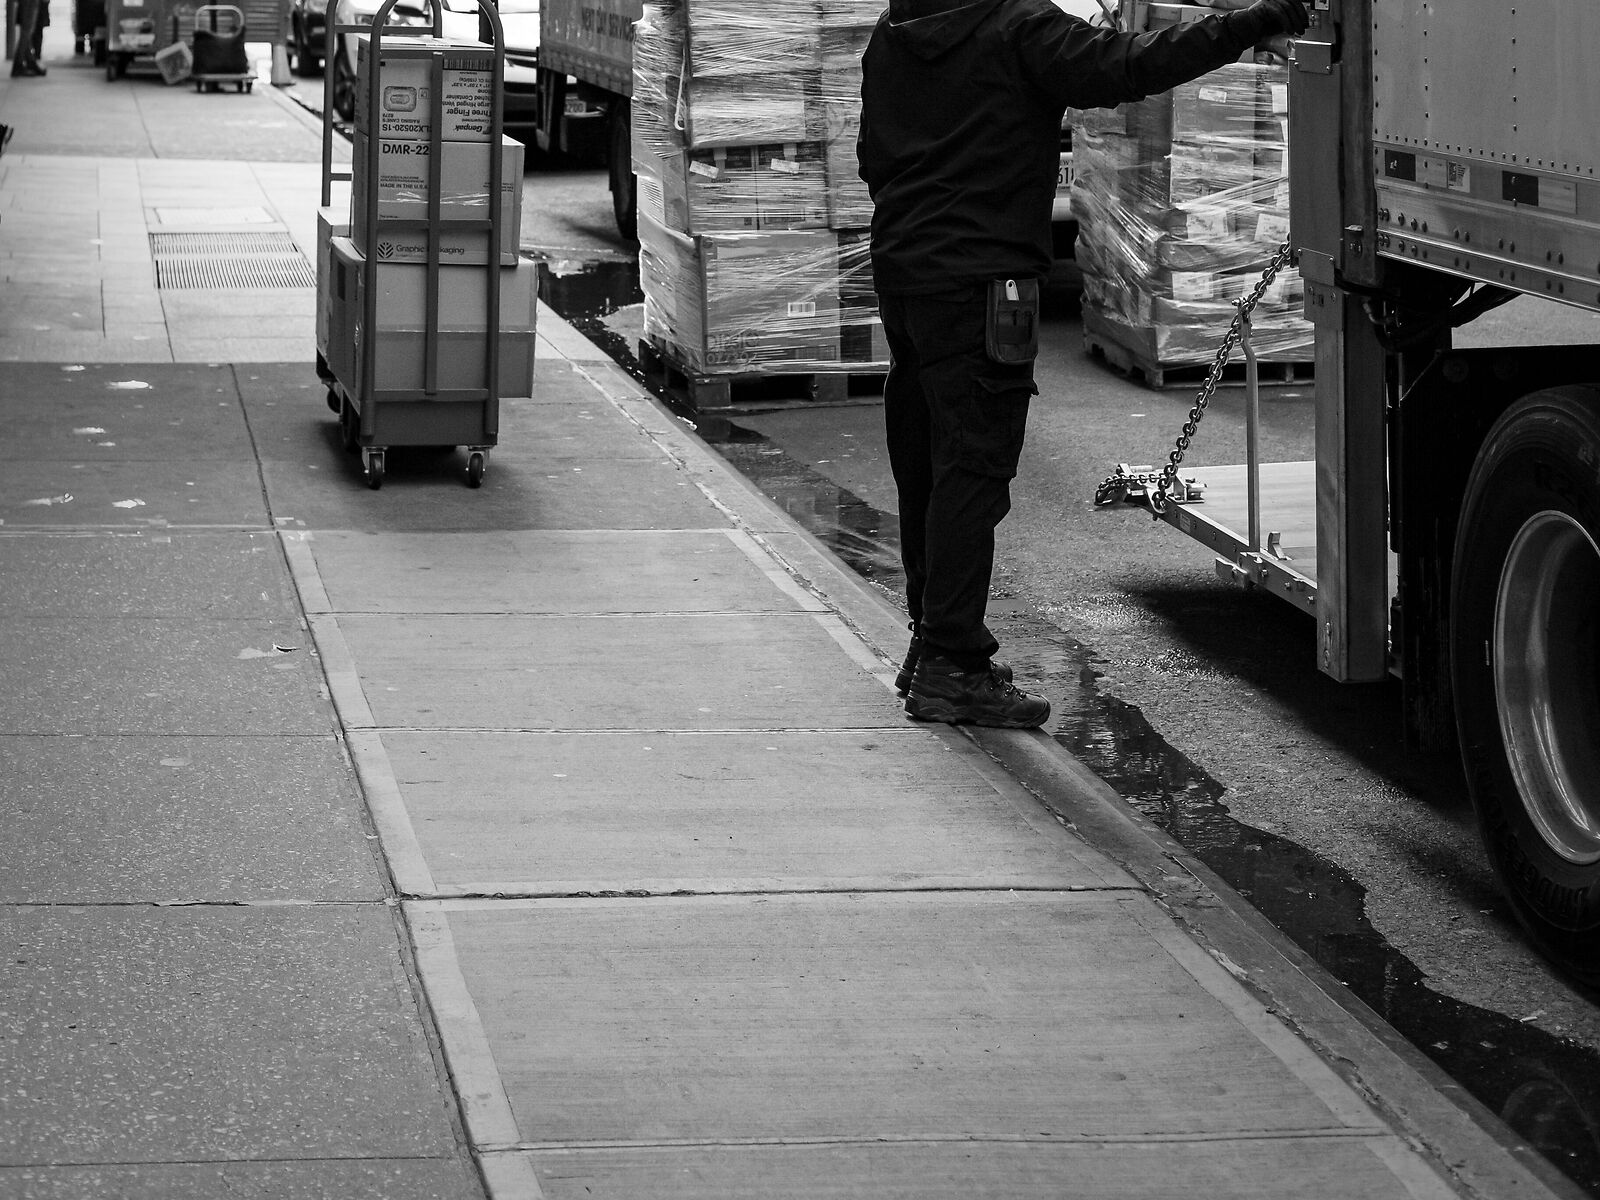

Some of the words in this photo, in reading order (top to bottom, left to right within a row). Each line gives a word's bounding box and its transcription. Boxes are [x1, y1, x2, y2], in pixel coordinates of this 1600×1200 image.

[446, 94, 473, 102] Container
[446, 107, 470, 117] Finger
[454, 123, 483, 133] Genpak
[382, 143, 430, 156] DMR-22
[438, 246, 465, 256] kaging
